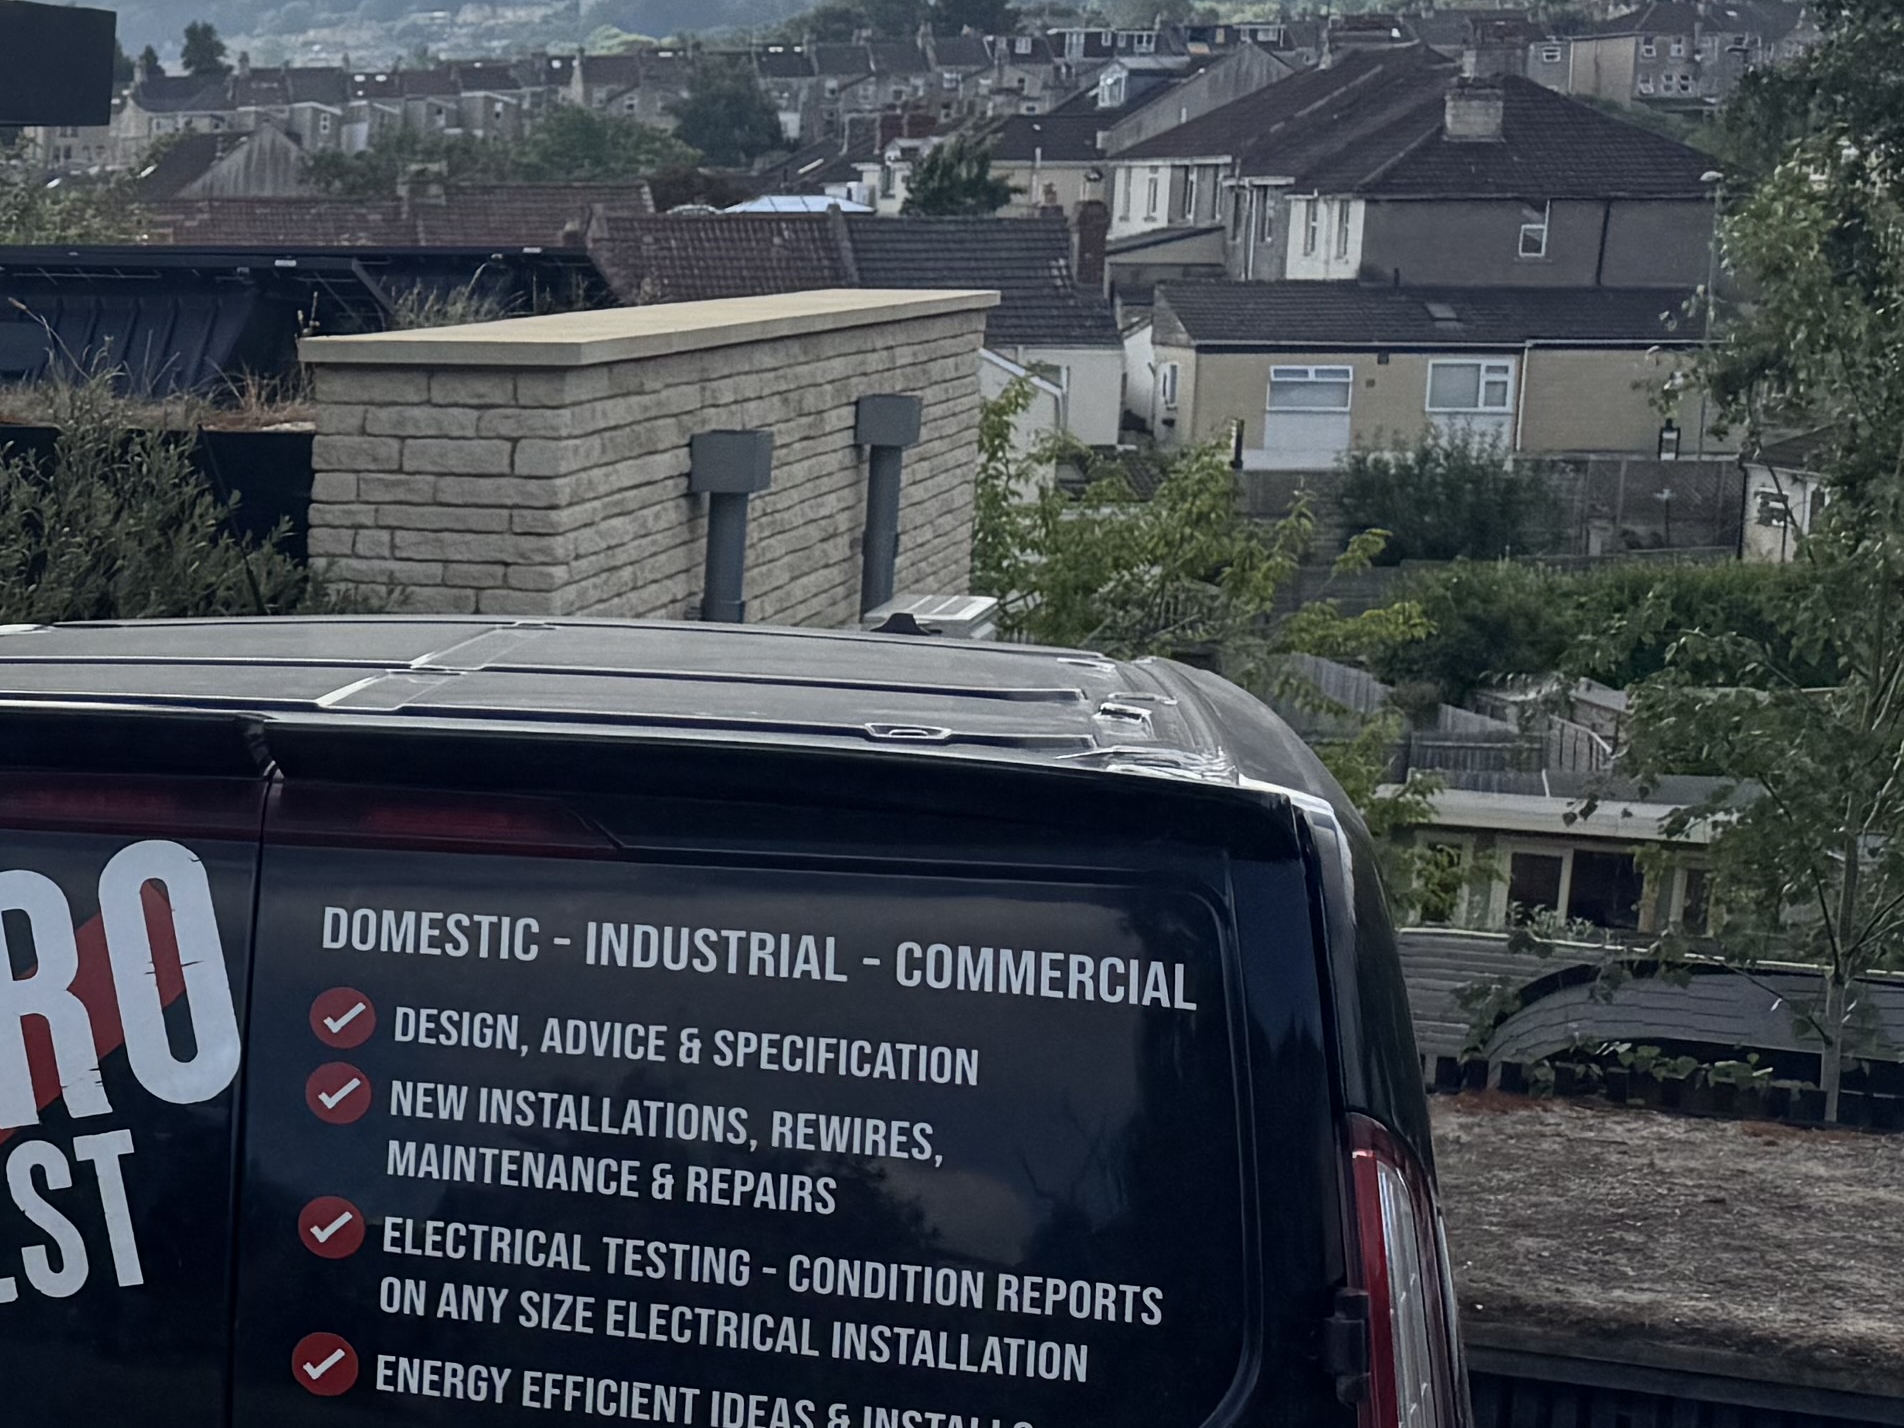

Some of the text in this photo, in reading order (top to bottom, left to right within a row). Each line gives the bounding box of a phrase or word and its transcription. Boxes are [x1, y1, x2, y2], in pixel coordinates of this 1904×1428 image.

[323, 907, 539, 960] DOMESTIC
[587, 922, 847, 981] INDUSTRIAL
[897, 942, 1196, 1010] COMMERCIAL
[395, 1007, 978, 1085] DESIGN, ADVICE & SPECIFICATION
[391, 1081, 942, 1167] NEW INSTALLATIONS, REWIRES,
[387, 1140, 836, 1214] MAINTENANCE & REPAIRS
[384, 1217, 590, 1271] ELECTRICAL
[603, 1237, 750, 1286] TESTING
[789, 1255, 984, 1308] CONDITION
[997, 1274, 1162, 1325] REPORTS
[380, 1277, 1087, 1382] ON ANY SIZE ELECTRICAL INSTALLATION
[376, 1355, 511, 1403] ENERGY
[523, 1371, 700, 1424] EFFICIENT
